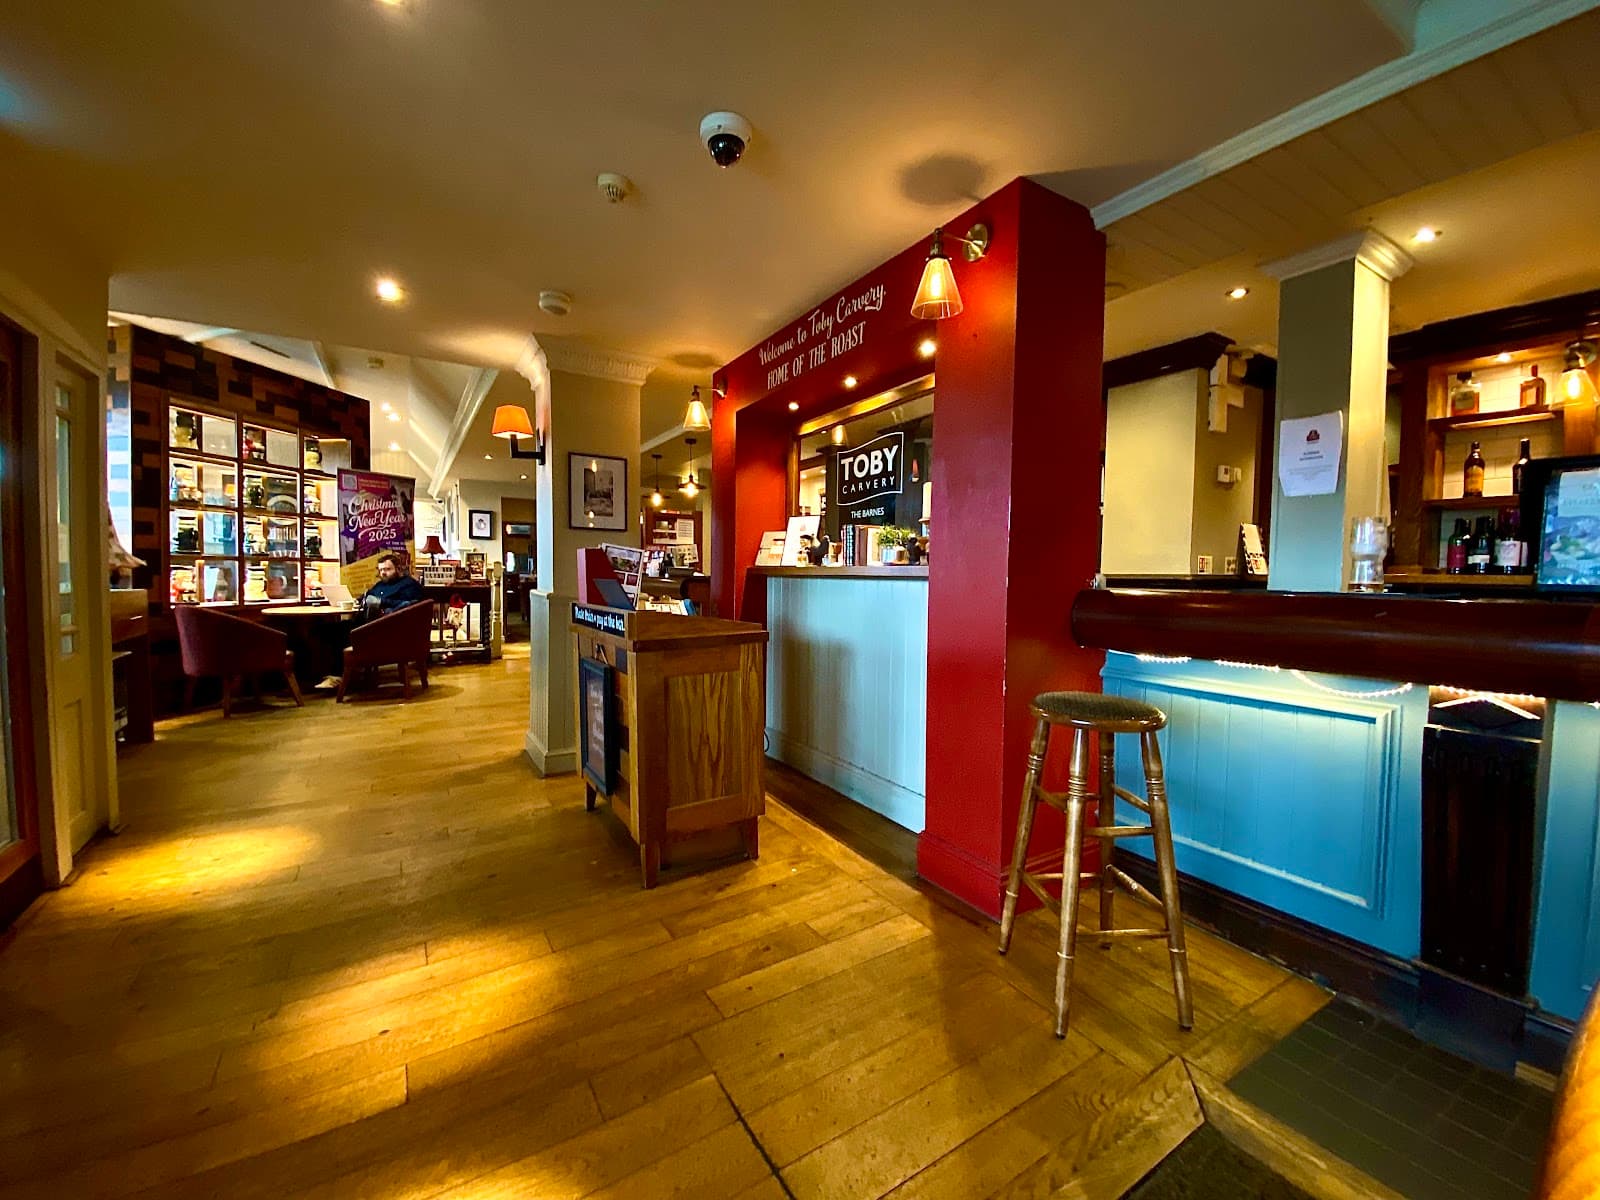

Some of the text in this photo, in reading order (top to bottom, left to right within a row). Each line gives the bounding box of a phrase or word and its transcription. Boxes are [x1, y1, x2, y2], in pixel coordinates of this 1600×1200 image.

[759, 341, 795, 366] Welcome
[797, 327, 807, 345] to
[808, 309, 834, 340] Toby
[767, 321, 866, 391] HOME OF THE ROAST
[840, 445, 899, 481] TOBY
[842, 475, 895, 495] CARVERY
[348, 513, 376, 532] New
[850, 507, 885, 519] THE BARNES
[368, 528, 397, 542] 2025
